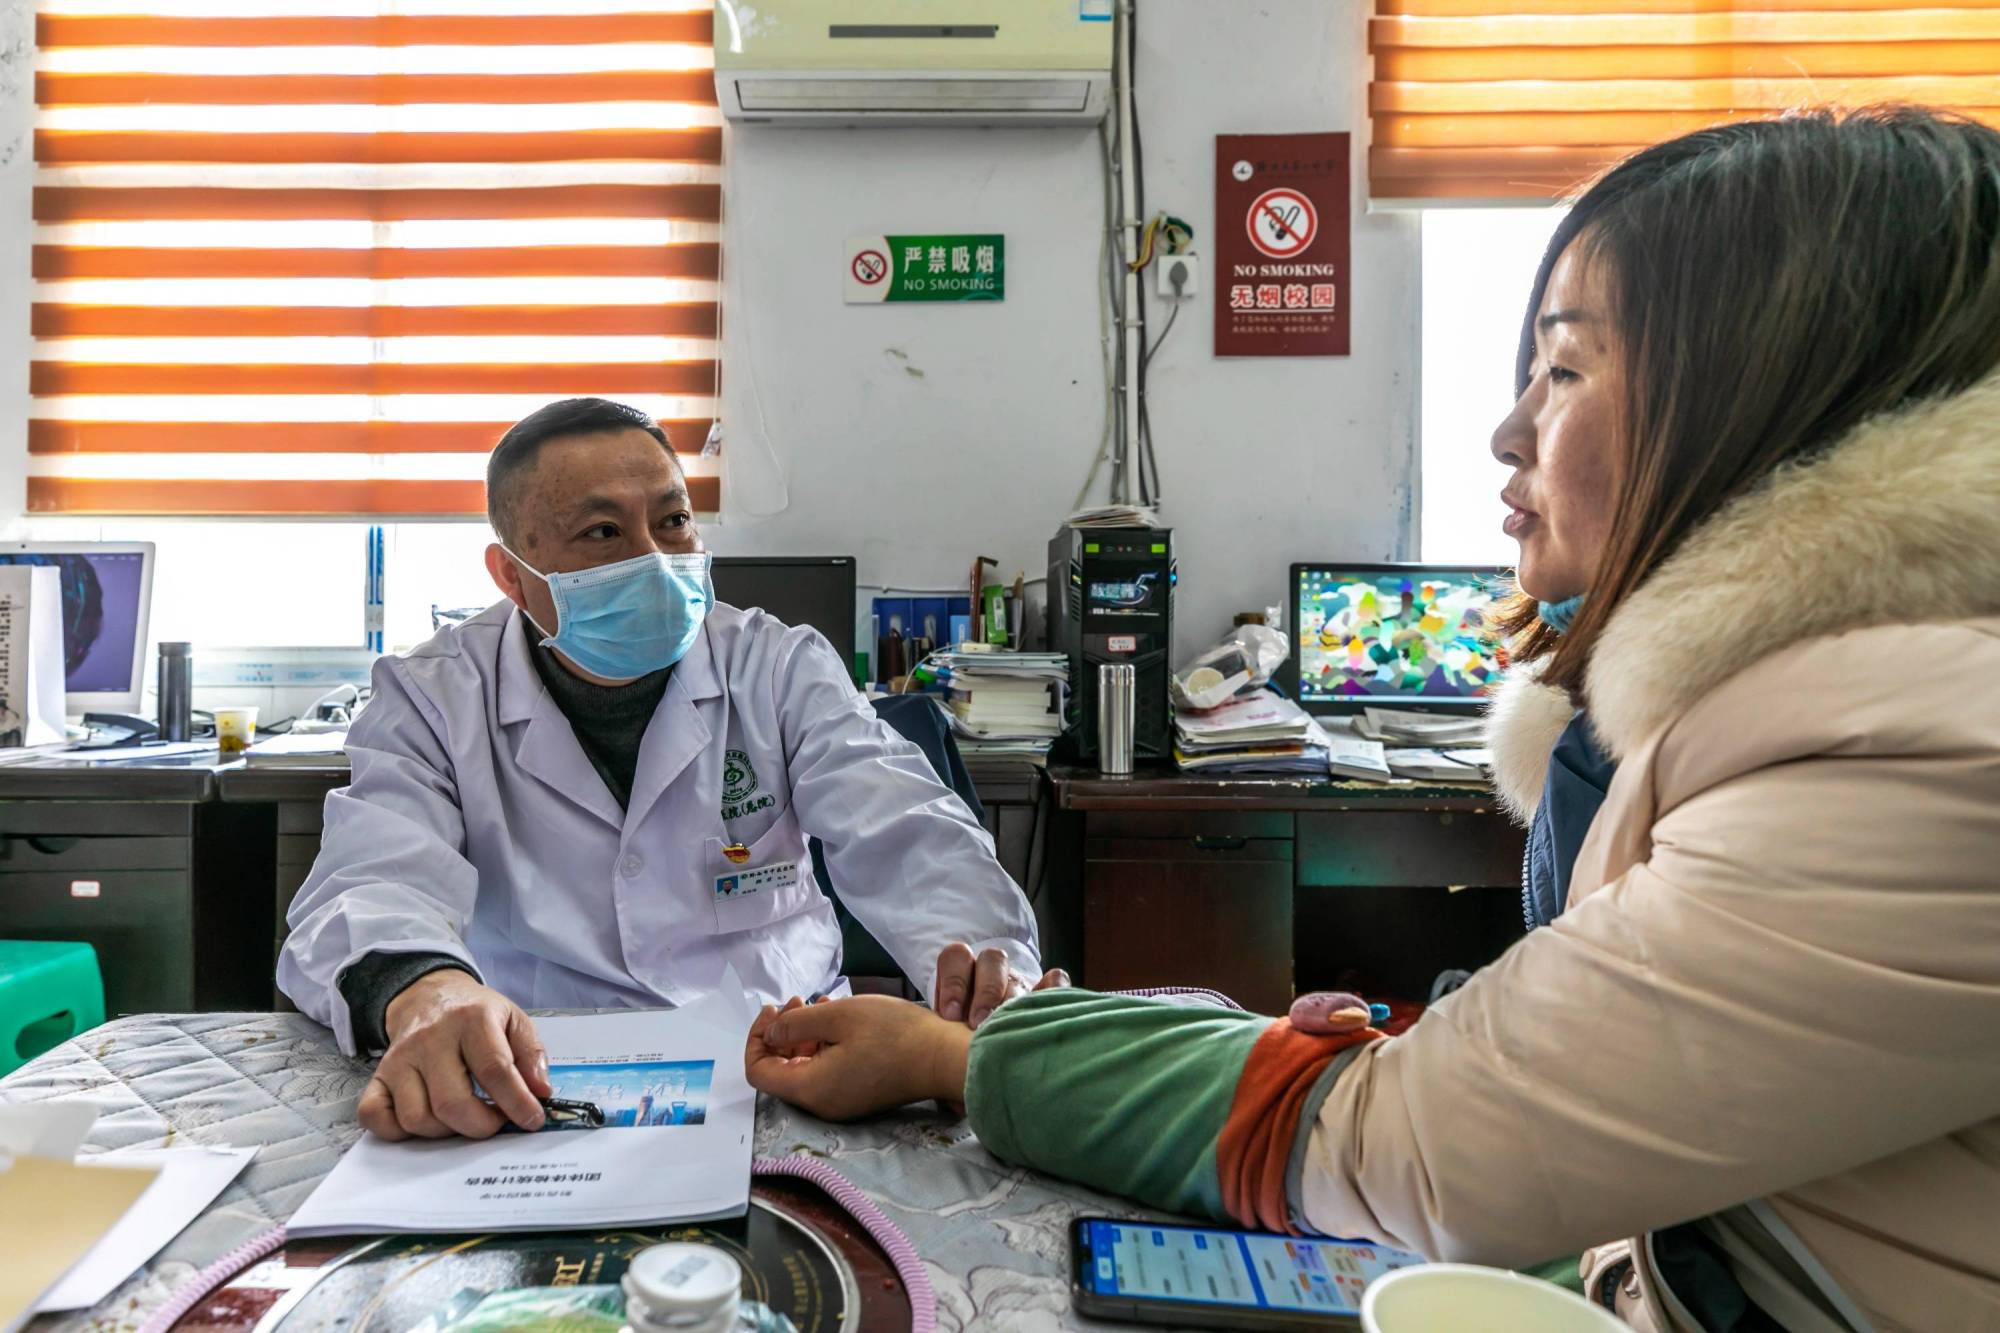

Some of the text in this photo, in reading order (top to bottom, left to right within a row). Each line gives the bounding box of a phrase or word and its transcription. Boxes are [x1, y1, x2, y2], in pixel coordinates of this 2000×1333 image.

[904, 245, 994, 274] 严禁吸烟
[1234, 264, 1334, 276] NO SMOKING
[904, 278, 994, 291] NO SMOKING
[1231, 284, 1335, 308] 无烟校园
[464, 1172, 602, 1186] 团体体检统计报告
